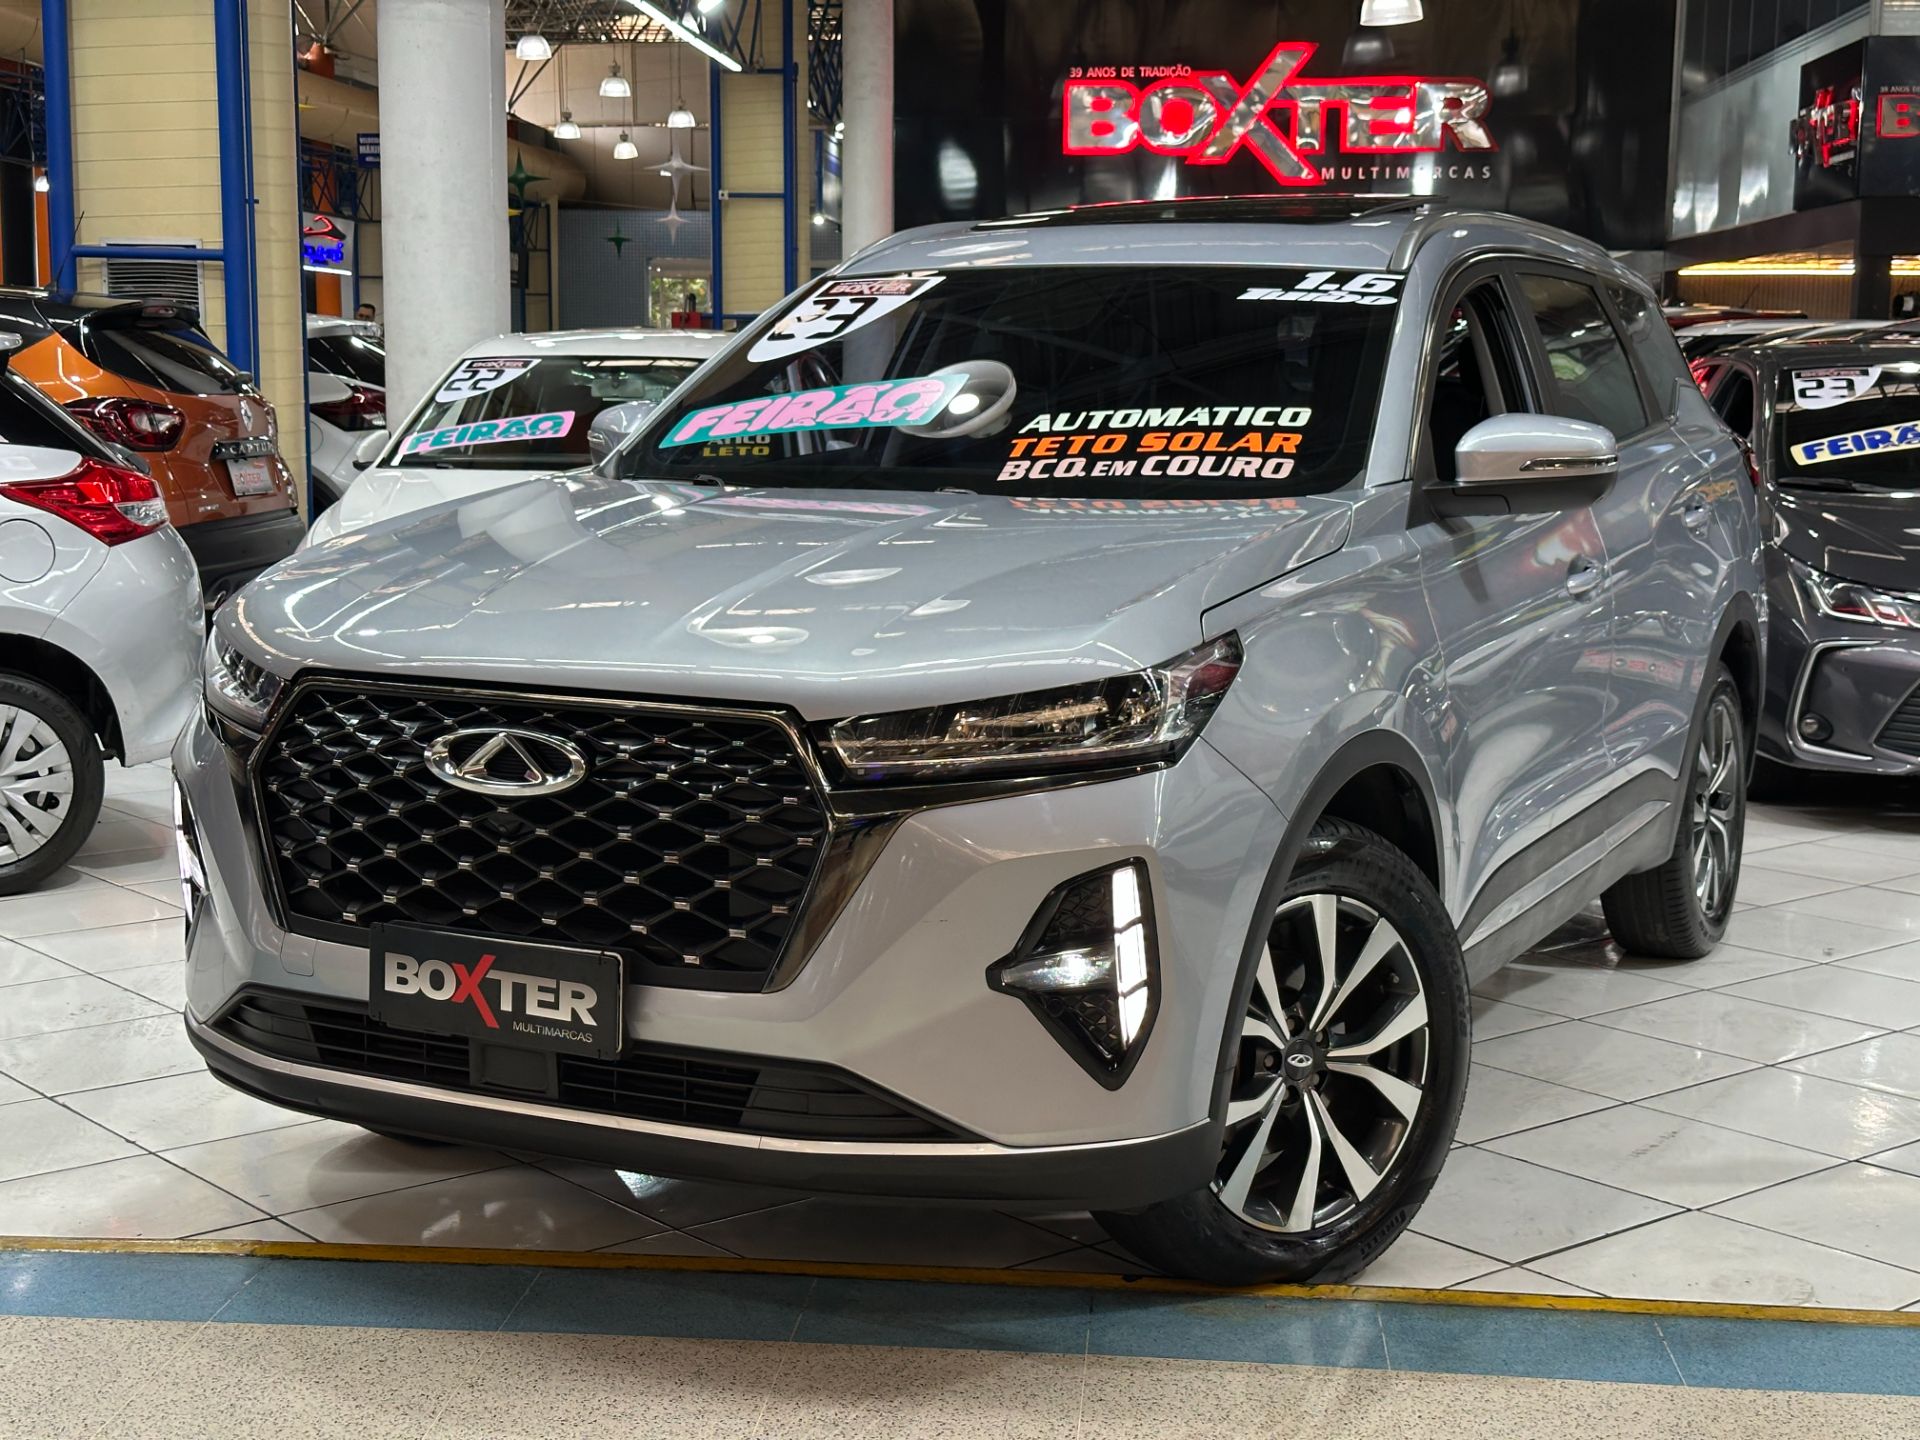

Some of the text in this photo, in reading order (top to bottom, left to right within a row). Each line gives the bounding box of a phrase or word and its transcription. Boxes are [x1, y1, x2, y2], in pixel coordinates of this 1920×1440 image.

[1069, 64, 1192, 78] 39 ANOS DE TRADIÇÃO
[1063, 42, 1499, 186] BOXTER
[1321, 165, 1491, 180] MULTIMRCAS
[829, 280, 912, 295] BOXTER
[1294, 271, 1405, 294] 1.6
[443, 369, 505, 392] 22
[1798, 378, 1857, 399] 23
[405, 414, 566, 452] FEIRÃO
[1008, 432, 1303, 458] TETO SOLAR
[1090, 460, 1138, 477] EM
[1140, 455, 1295, 480] COURO
[384, 951, 598, 1030] BOXTER
[512, 1020, 594, 1044] MULTIMARCAS
